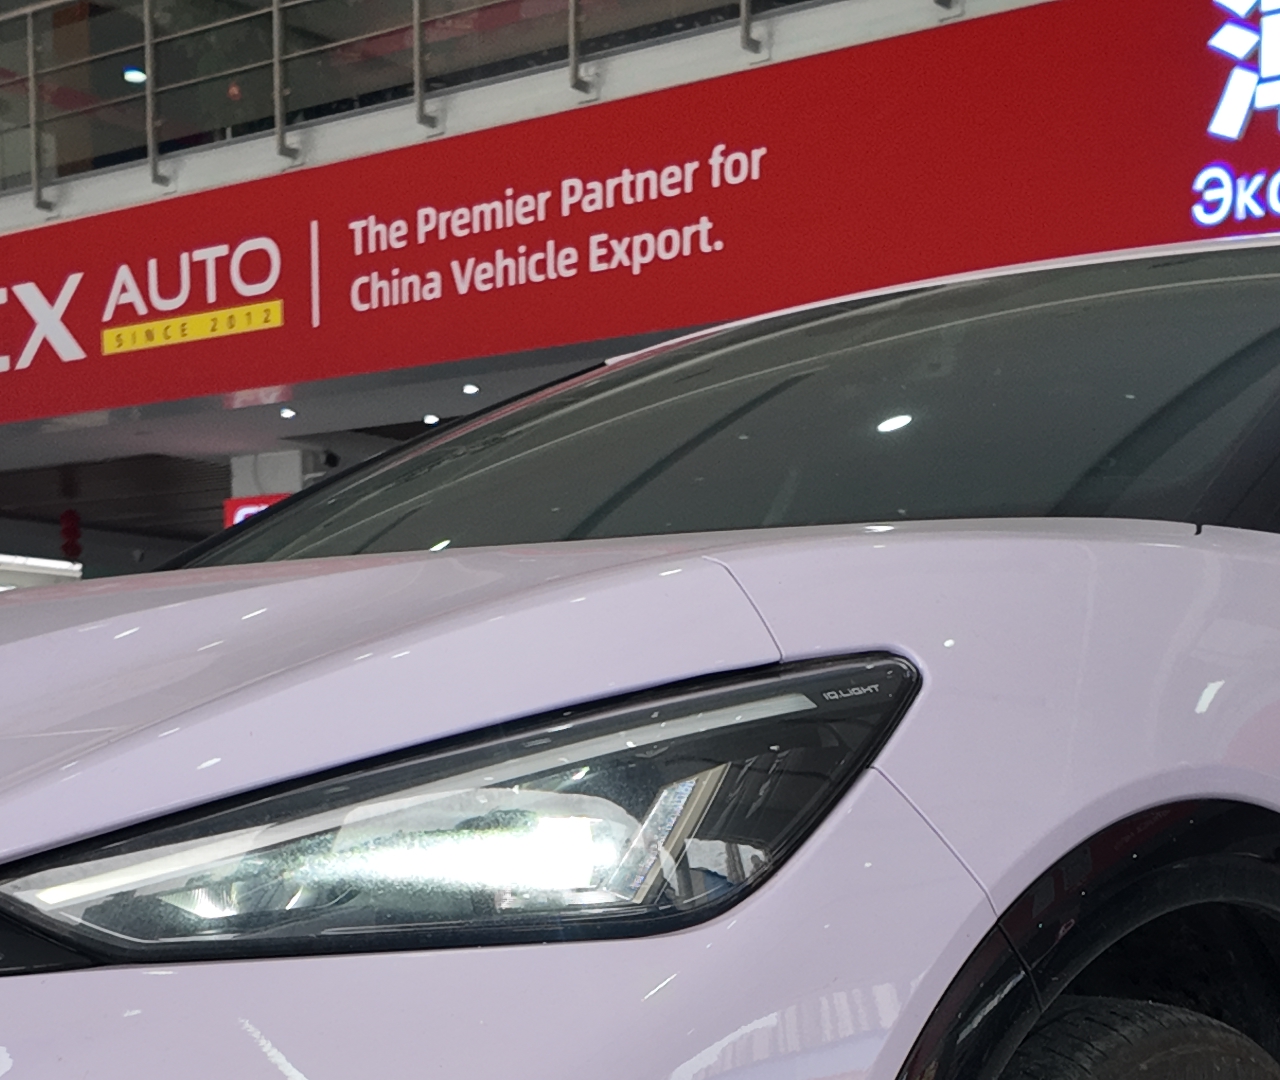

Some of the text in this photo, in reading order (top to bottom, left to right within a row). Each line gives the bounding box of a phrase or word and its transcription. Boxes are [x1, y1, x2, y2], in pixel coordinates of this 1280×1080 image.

[350, 145, 768, 257] The Premier Partner for
[102, 237, 282, 322] AUTO
[350, 216, 725, 312] China Vehicle Export.
[114, 307, 274, 350] SINCE 2012
[822, 684, 880, 701] IQ.LIGHT
